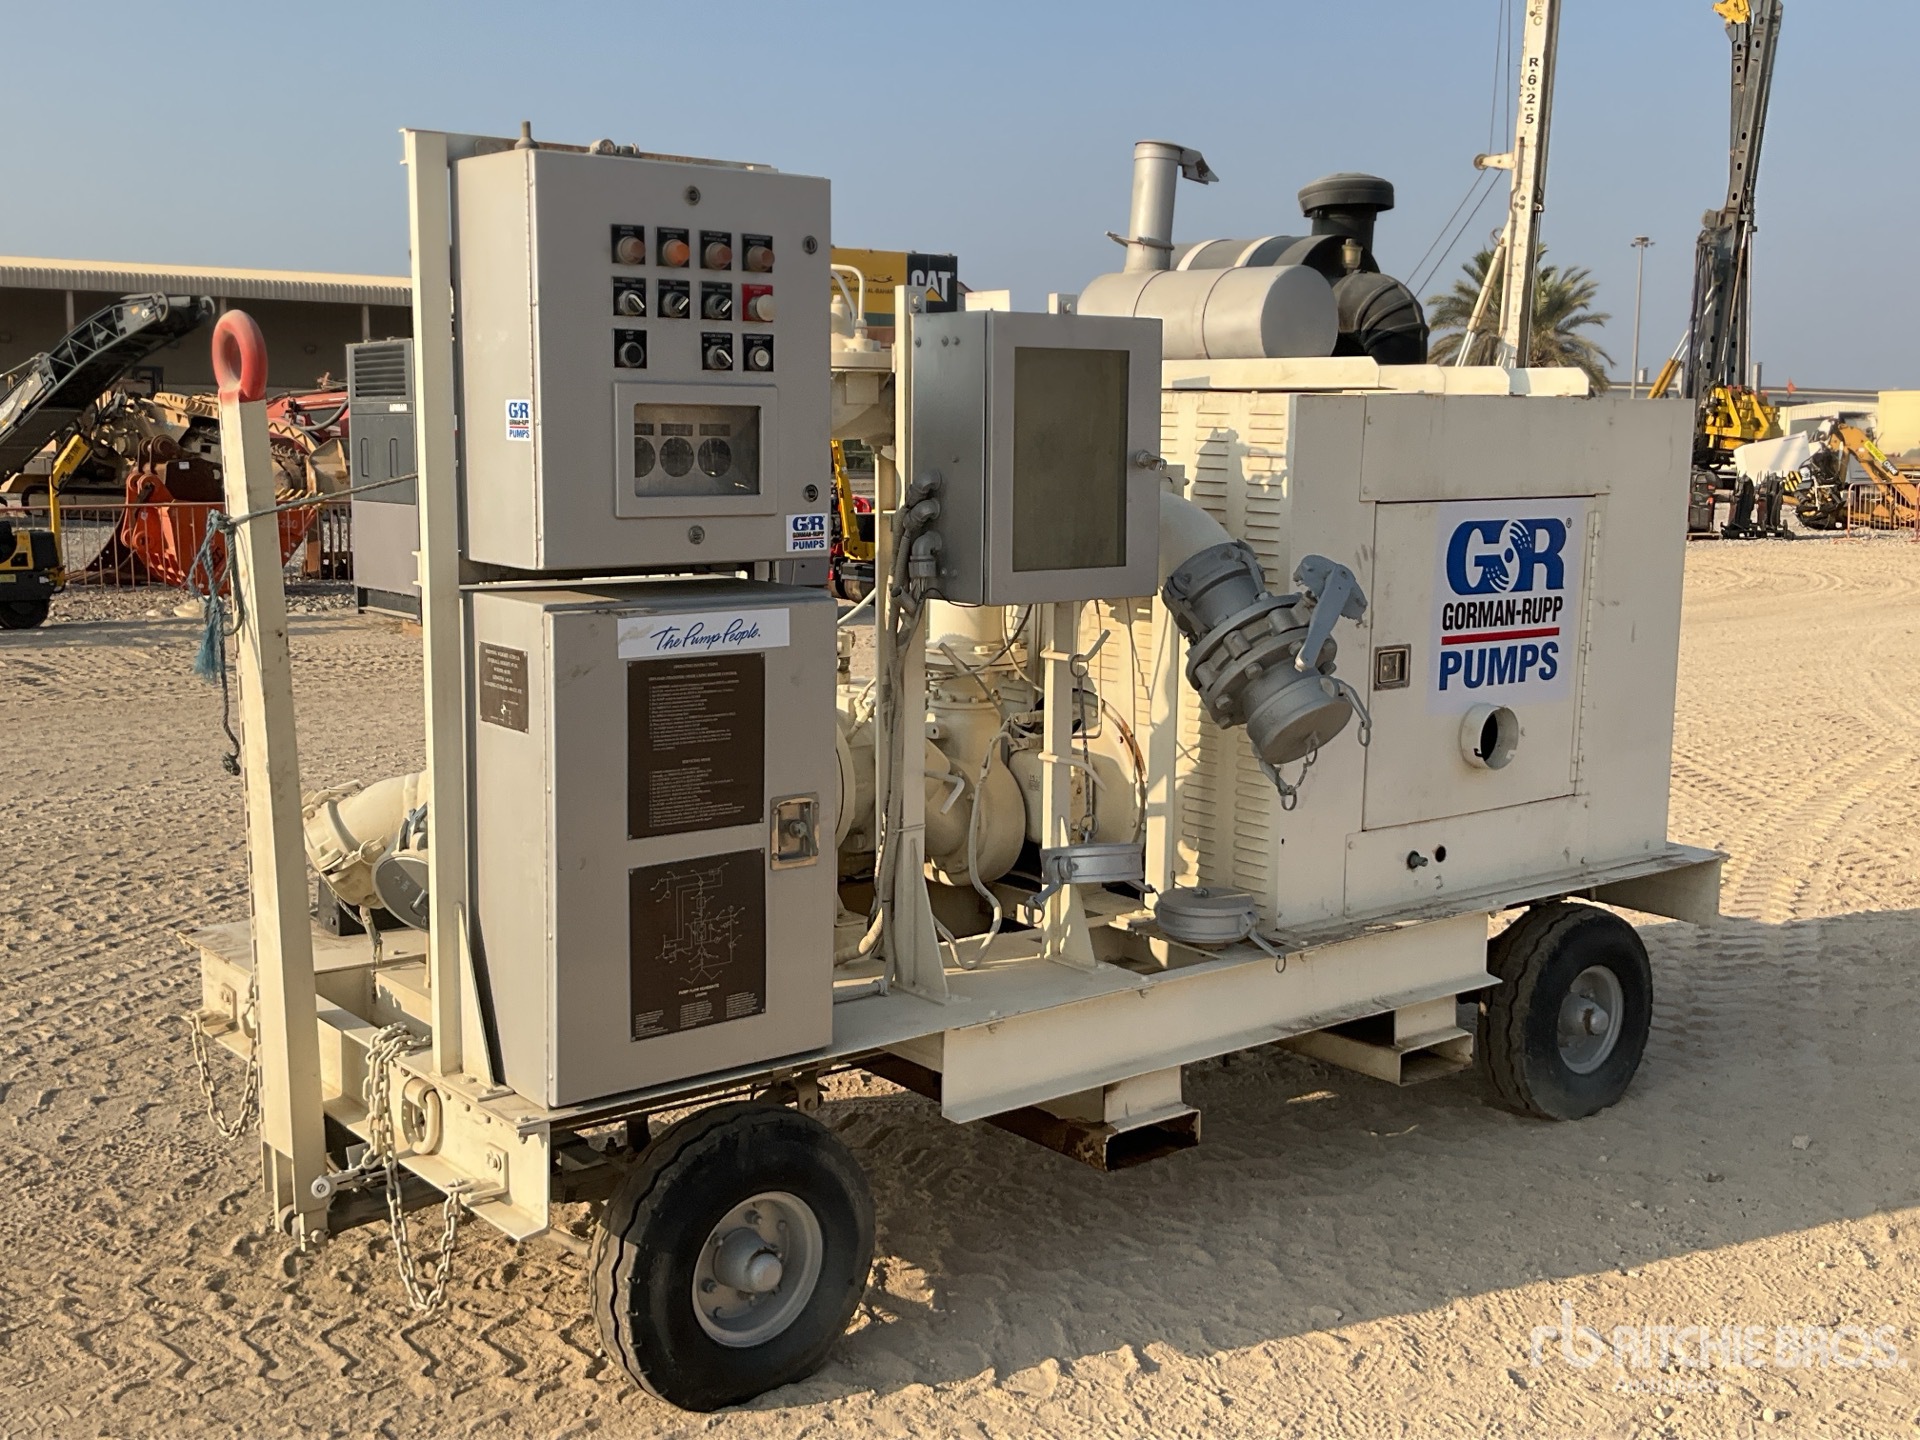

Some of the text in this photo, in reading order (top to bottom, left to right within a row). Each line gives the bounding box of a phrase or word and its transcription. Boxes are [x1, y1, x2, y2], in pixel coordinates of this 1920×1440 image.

[911, 269, 951, 302] CAT
[509, 429, 530, 438] PUMPS
[792, 540, 825, 550] PUMPS
[1442, 596, 1563, 631] GORMAN-RUPP
[650, 625, 682, 650] The
[682, 621, 722, 650] Pump
[1438, 641, 1559, 691] PUMPS
